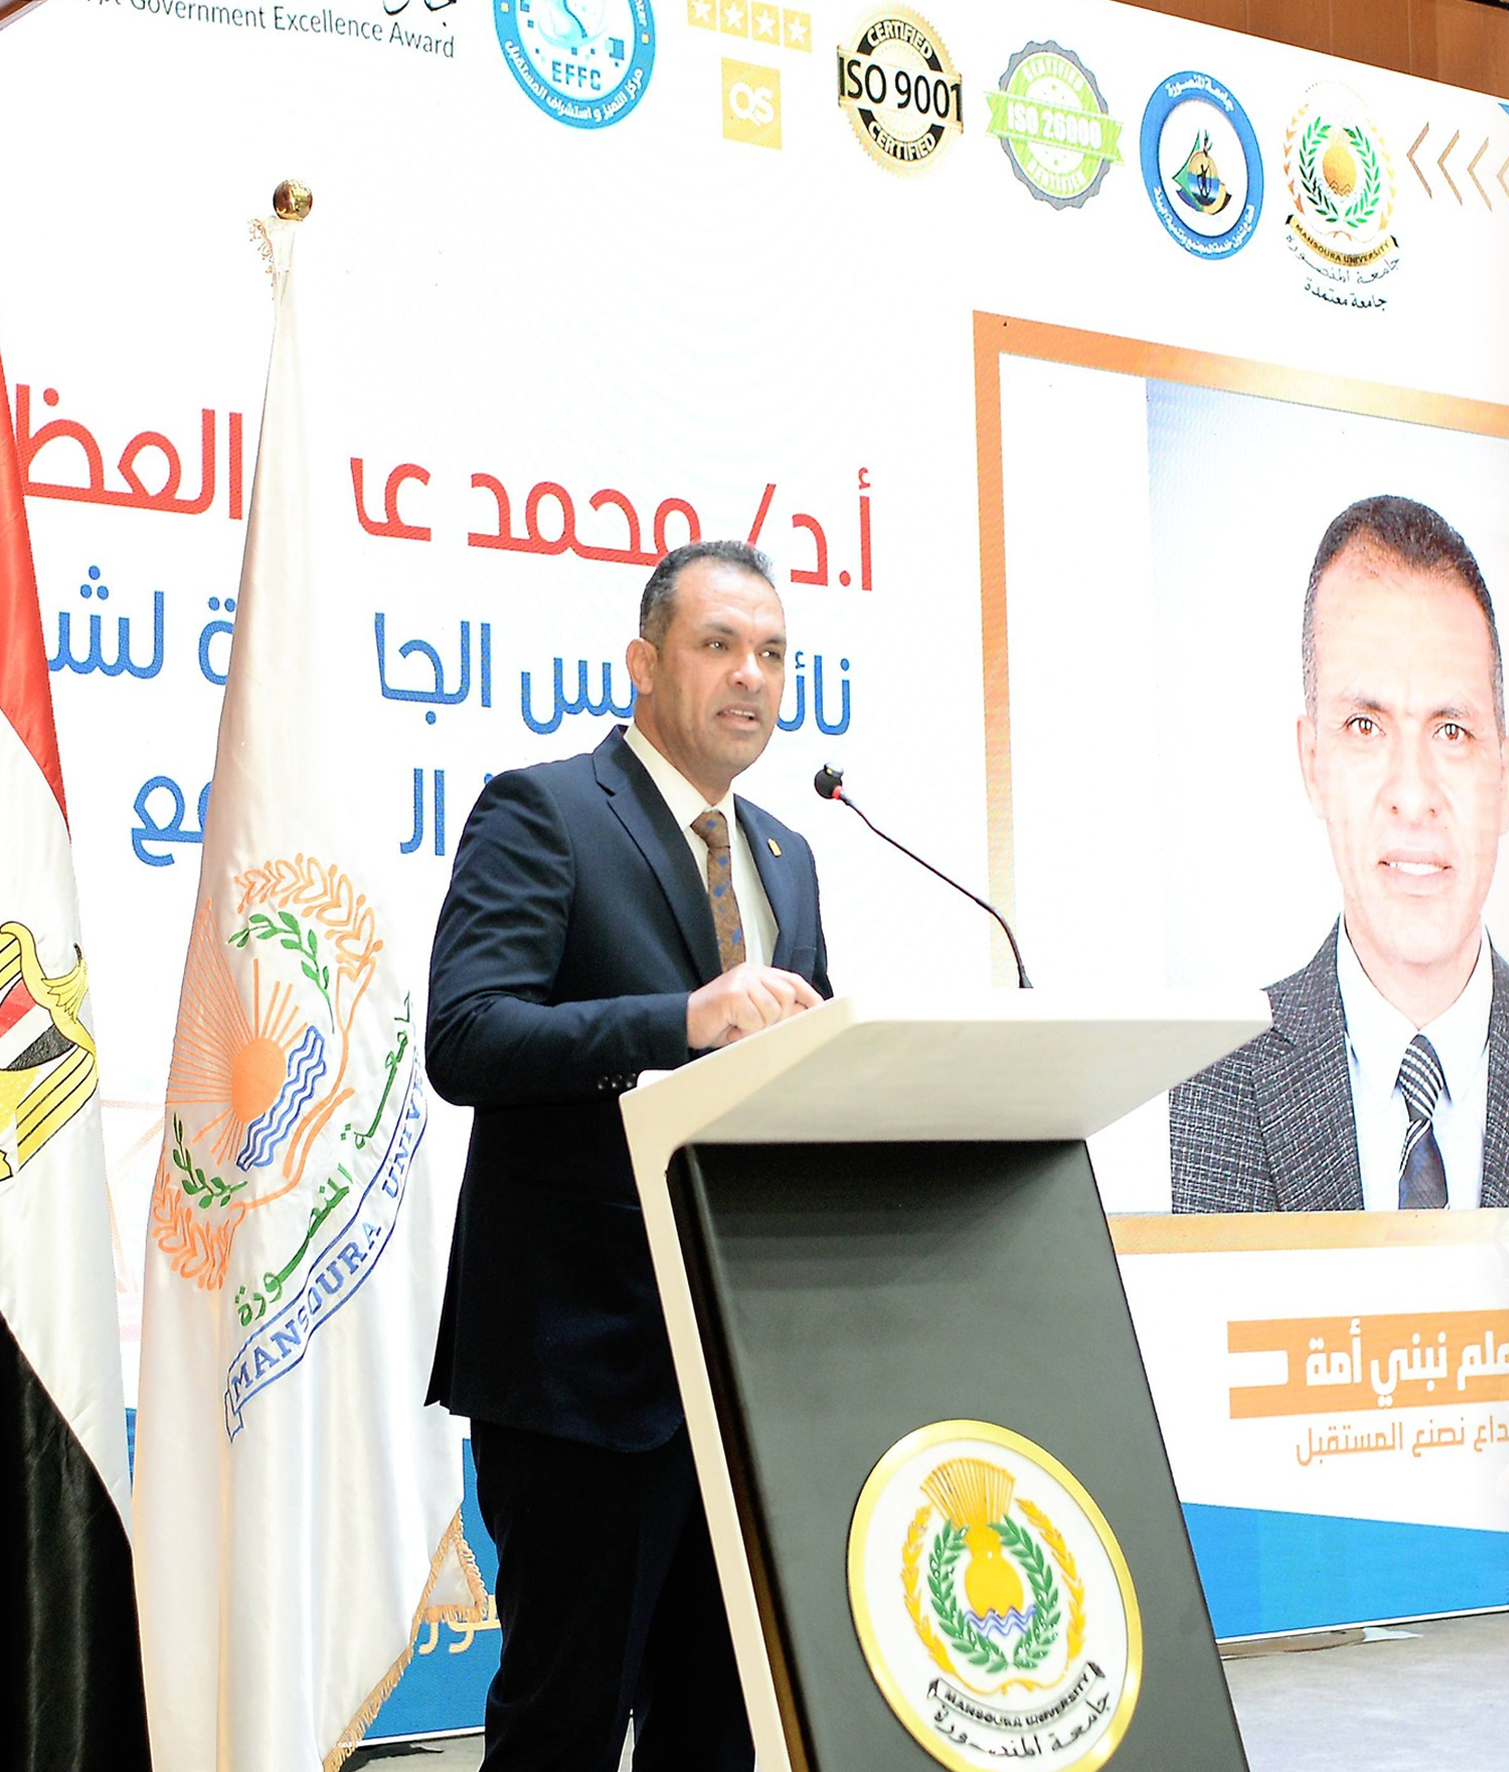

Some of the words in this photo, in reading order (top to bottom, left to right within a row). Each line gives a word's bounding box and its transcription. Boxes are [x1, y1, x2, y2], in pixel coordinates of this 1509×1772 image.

[274, 6, 383, 41] Excellence
[389, 22, 454, 58] Award
[867, 20, 933, 59] CERTIFIED
[552, 60, 601, 91] EFFC
[839, 57, 887, 104] ISO
[895, 71, 962, 122] 9001
[729, 82, 775, 127] QS
[1007, 101, 1040, 136] ISO
[1041, 109, 1103, 149] 26000
[868, 121, 936, 162] CERTIFIED
[1295, 224, 1342, 262] MANSOURA
[1343, 240, 1390, 263] UNIVERSITY
[1304, 277, 1348, 306] معتمدة
[1351, 292, 1387, 311] جامعة
[16, 383, 243, 521] العظ
[467, 472, 702, 568] محمد
[776, 650, 851, 736] نائ
[231, 1220, 382, 1401] MANSOURA
[1306, 1318, 1362, 1387] أمة
[1370, 1331, 1448, 1407] نبني
[1296, 1421, 1404, 1467] المستقبل
[1411, 1416, 1465, 1457] نصنع
[944, 1688, 1023, 1728] MANSOURA
[1025, 1673, 1089, 1726] UNIVERSITY
[1048, 1692, 1110, 1751] جامعة
